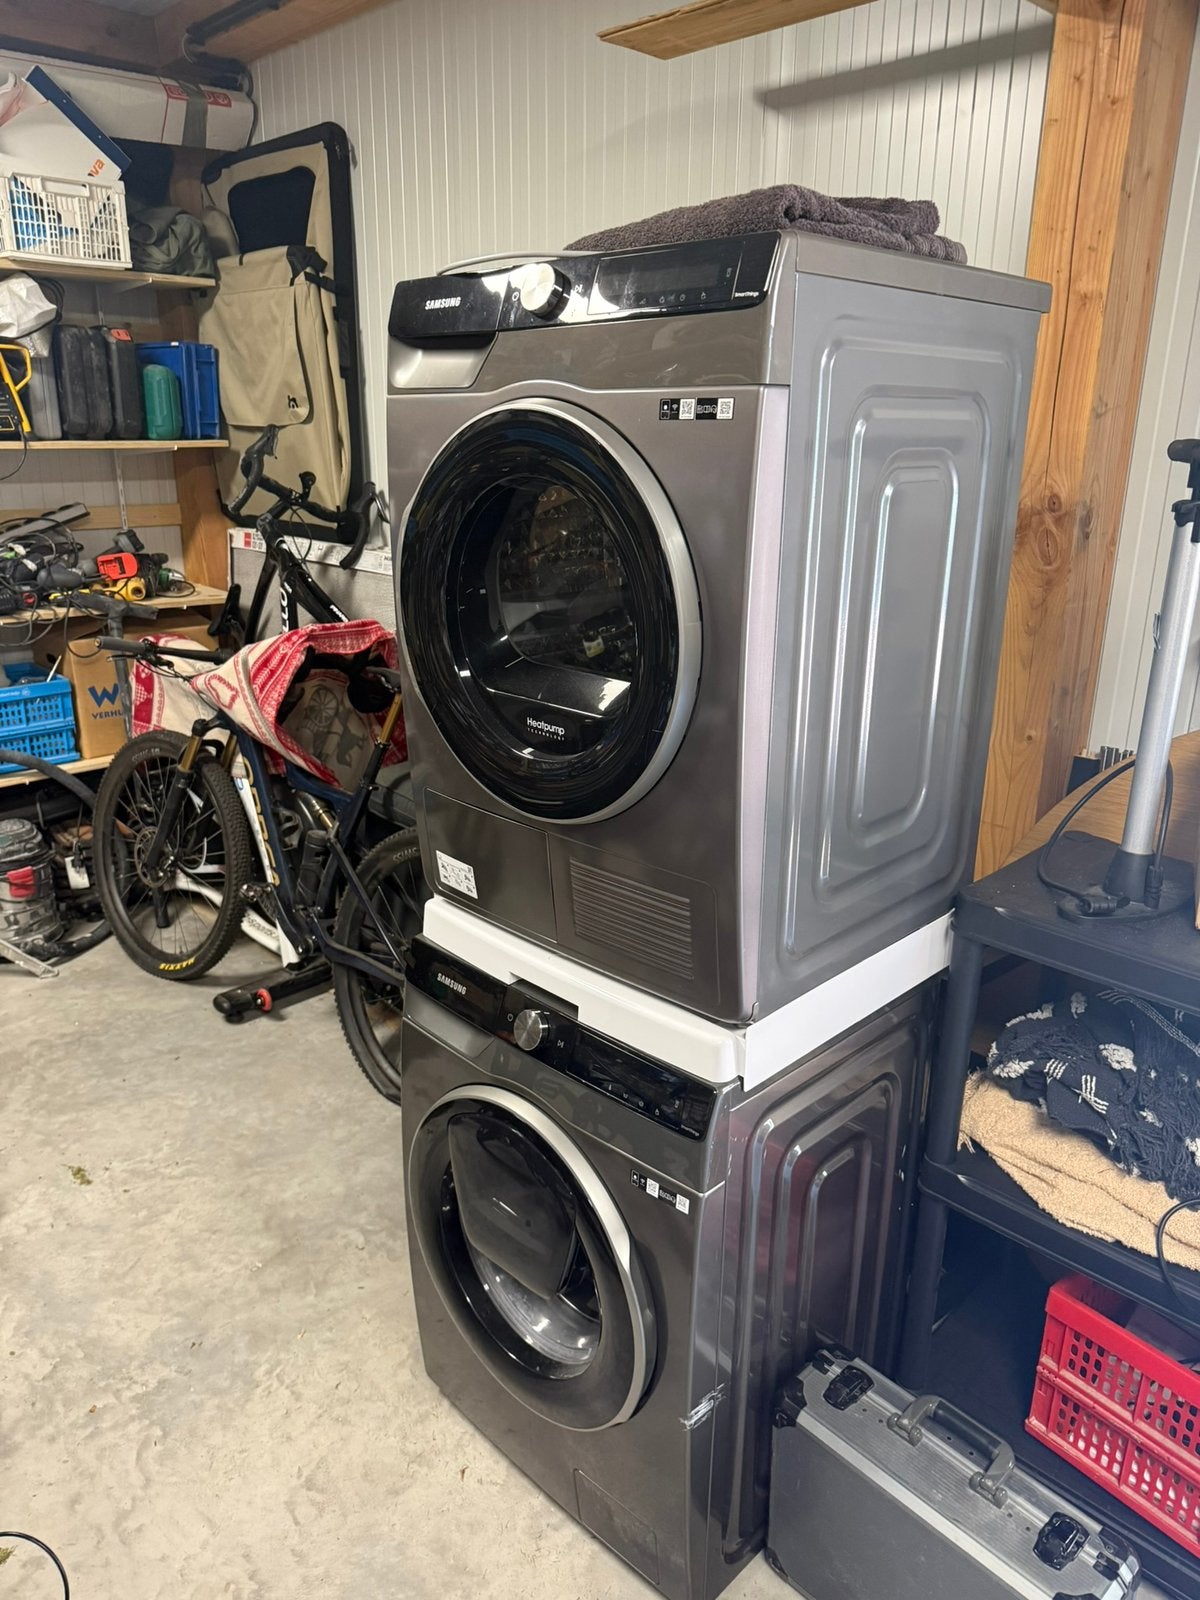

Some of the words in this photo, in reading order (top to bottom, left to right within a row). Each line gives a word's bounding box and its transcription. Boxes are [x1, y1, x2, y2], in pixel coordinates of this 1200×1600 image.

[425, 297, 461, 310] SAMSUNG
[526, 716, 565, 736] Heatpump
[159, 957, 196, 970] MAXXIS
[437, 972, 467, 995] SAMSUNG
